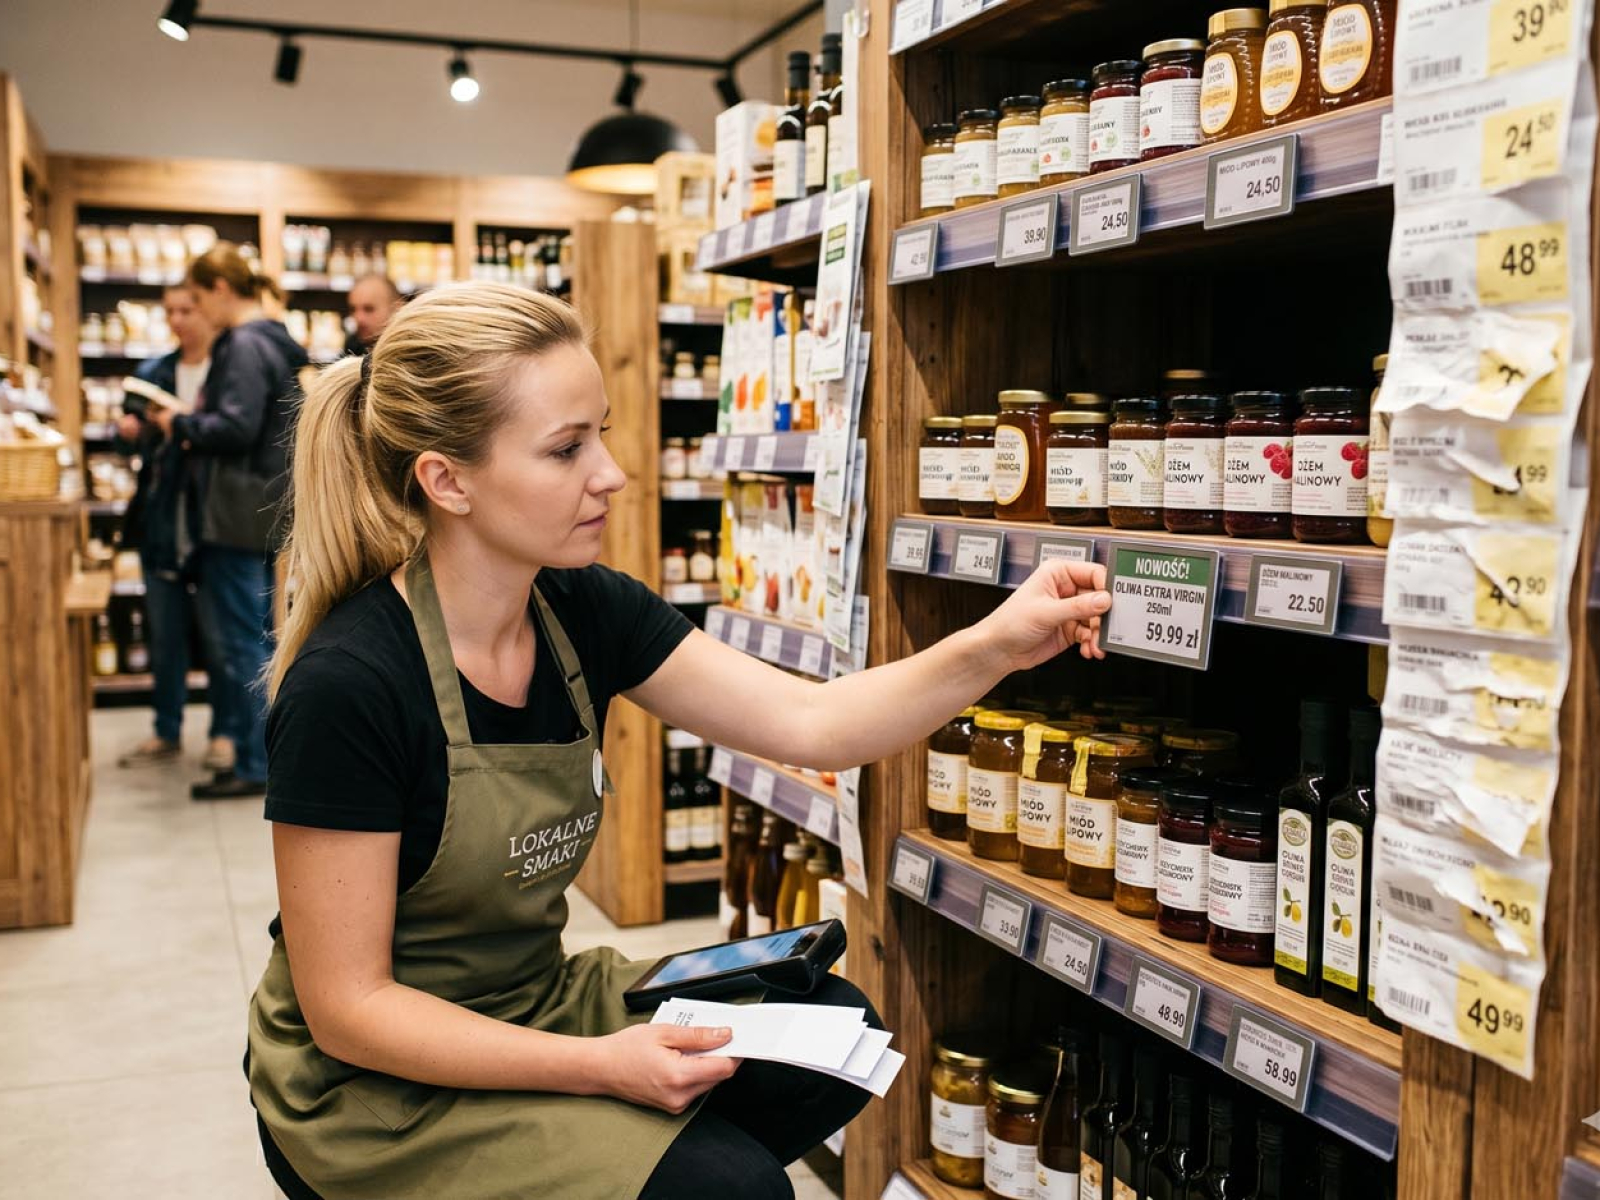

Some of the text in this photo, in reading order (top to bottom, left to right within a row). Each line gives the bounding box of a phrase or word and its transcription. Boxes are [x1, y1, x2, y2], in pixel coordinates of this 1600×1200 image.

[1512, 4, 1545, 43] 39
[1504, 119, 1534, 160] 24
[1501, 238, 1560, 276] 48 99
[1525, 464, 1547, 483] 99
[1135, 557, 1190, 580] NOWOŚĆ!
[1115, 580, 1205, 605] OLIWA EXTRA VIRGIN
[1525, 577, 1547, 595] 90
[1146, 601, 1173, 616] 250ml
[1287, 593, 1325, 614] 22.50
[1146, 621, 1199, 649] 59.99 zł
[1020, 797, 1045, 811] MIÓD
[1069, 814, 1096, 829] MIÓD
[509, 811, 598, 859] LOKALNE
[521, 839, 581, 878] SMAKI
[1510, 902, 1532, 926] 90
[1467, 997, 1524, 1035] 49 99
[1264, 1058, 1297, 1087] 58.99
